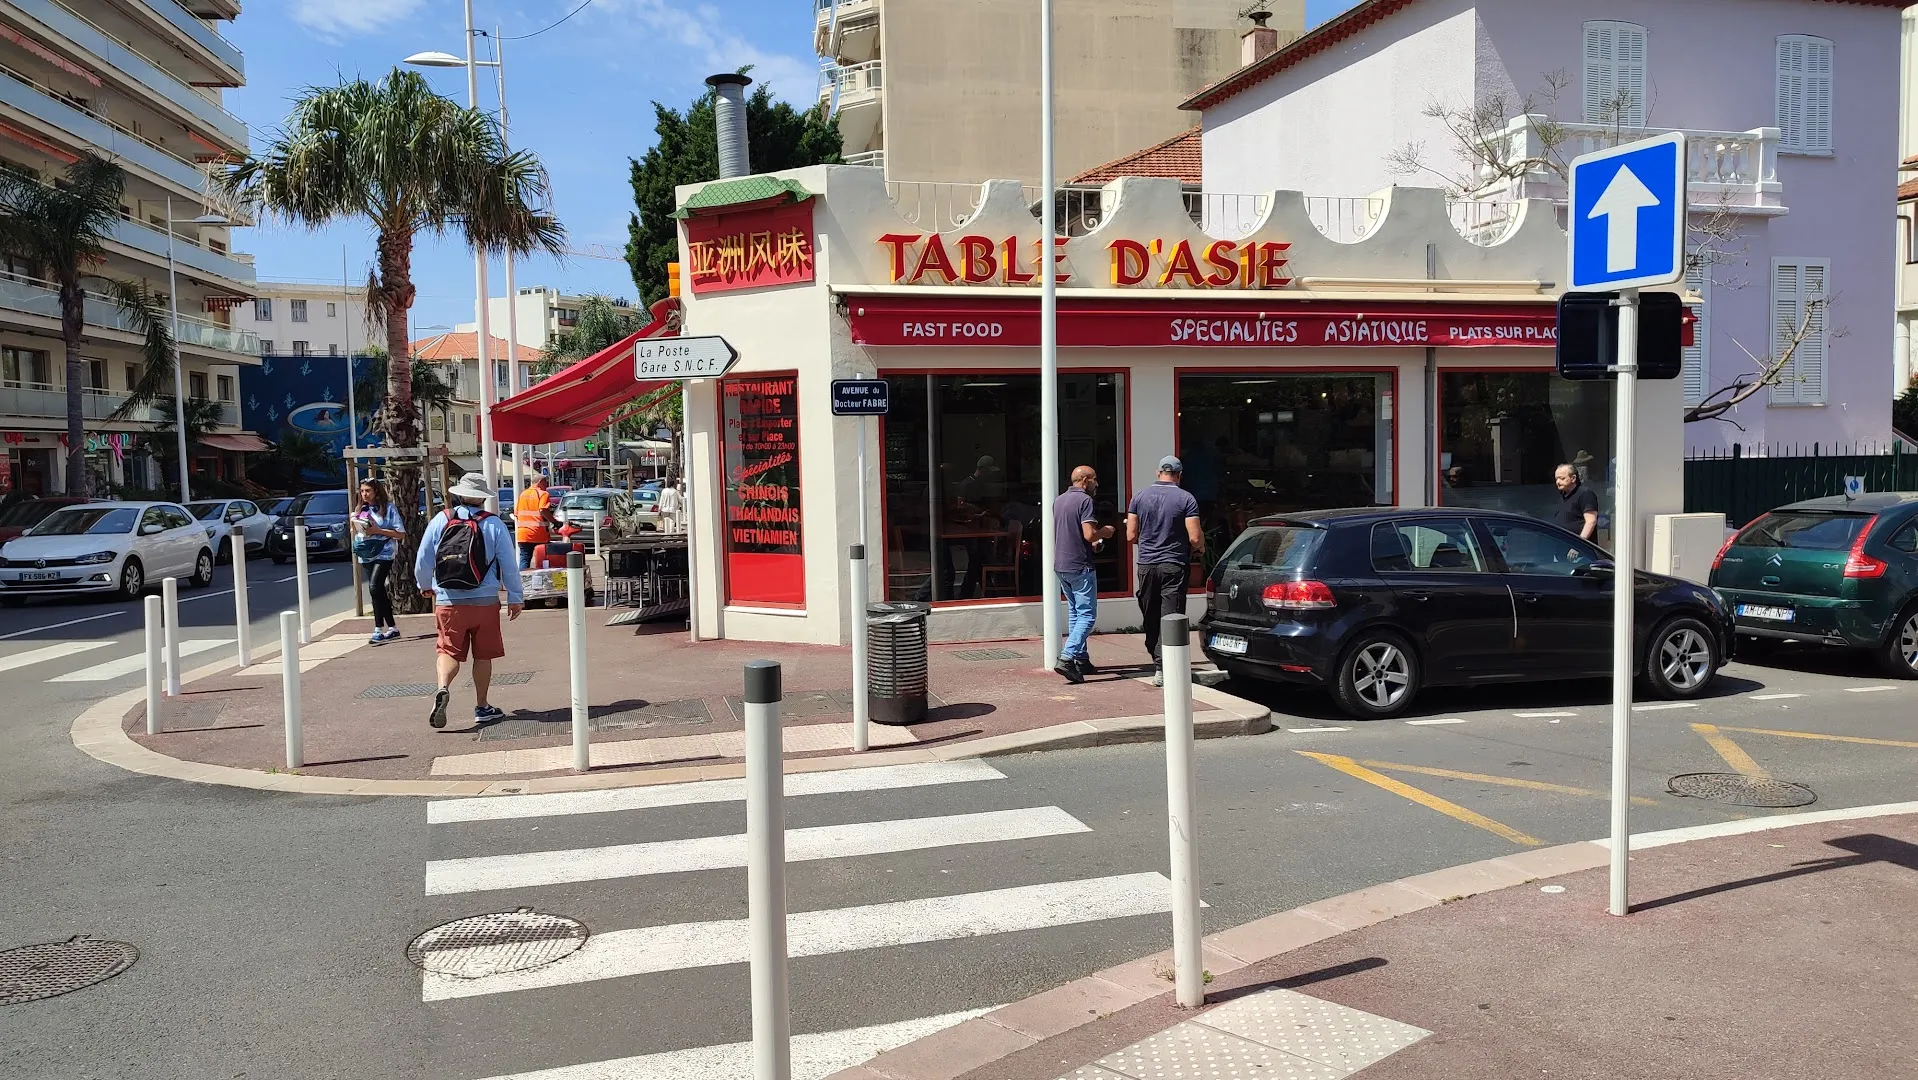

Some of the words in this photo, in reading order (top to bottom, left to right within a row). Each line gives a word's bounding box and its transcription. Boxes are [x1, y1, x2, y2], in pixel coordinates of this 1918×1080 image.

[689, 226, 809, 276] 亚洲风味
[875, 233, 1072, 285] TABLE
[1105, 238, 1293, 288] D'ASIE
[902, 322, 947, 338] FAST
[952, 322, 1003, 338] FOOD
[1324, 320, 1429, 343] ASIATIQUE
[1449, 326, 1492, 340] PLATS
[1495, 326, 1523, 339] SUR
[1525, 326, 1557, 339] PLAC
[640, 346, 652, 358] La
[658, 345, 690, 357] Poste
[641, 361, 667, 373] Gare
[674, 358, 718, 372] S.N.C.F.
[725, 381, 794, 397] RESTAURANT
[841, 386, 869, 395] AVENUE
[872, 386, 880, 394] du
[738, 398, 781, 414] RAPIDE
[834, 399, 862, 408] Docteur
[862, 398, 887, 407] FABRE
[762, 431, 783, 441] Place
[733, 452, 792, 482] Spécialités
[737, 485, 789, 501] CHINOIS
[729, 506, 799, 523] THAILANDAIS
[733, 528, 797, 545] VIETNAMIEN
